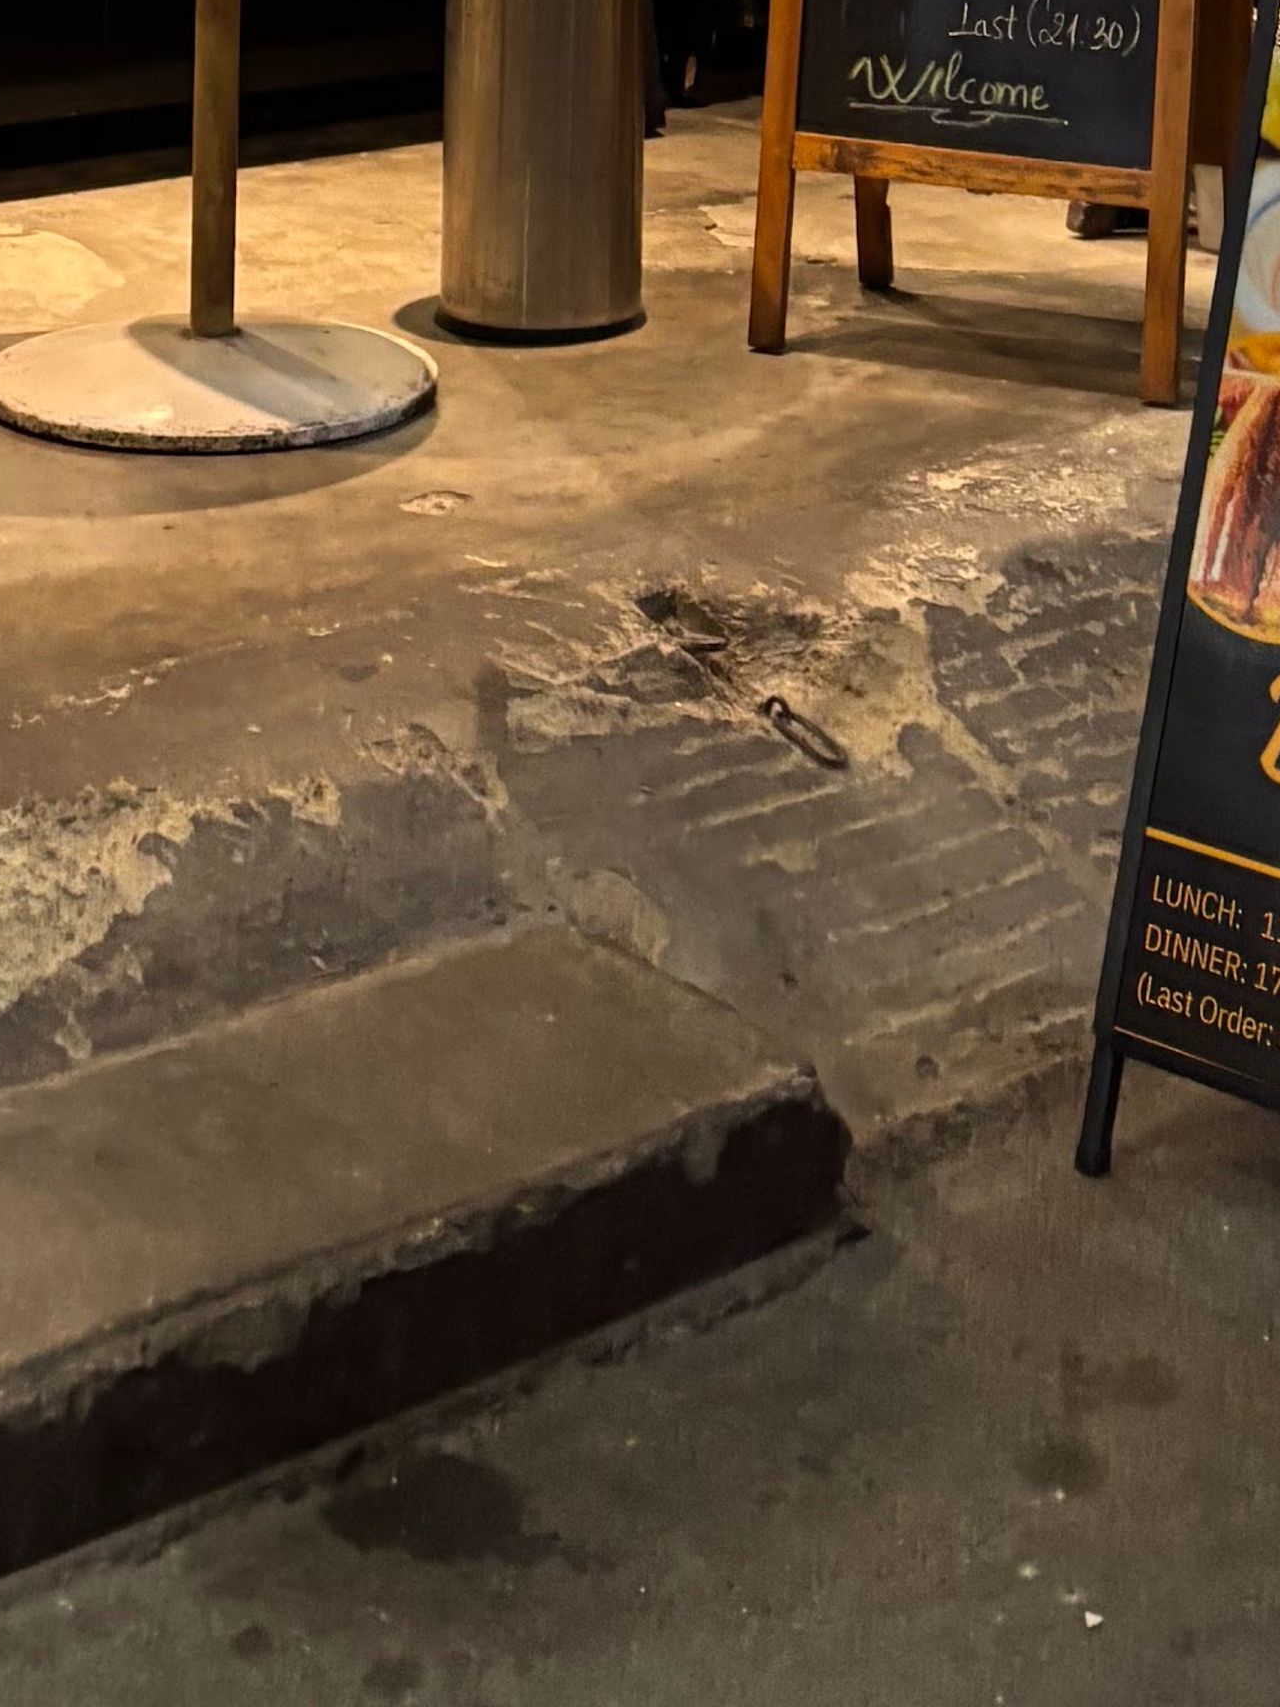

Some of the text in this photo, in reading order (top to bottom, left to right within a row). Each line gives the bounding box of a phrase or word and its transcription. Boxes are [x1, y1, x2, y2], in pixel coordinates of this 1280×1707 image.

[948, 2, 1018, 40] Last
[1153, 874, 1243, 930] LUNCH:
[1144, 922, 1248, 985] DINNER:
[1136, 971, 1193, 1018] (Last
[1199, 995, 1274, 1047] Order:
